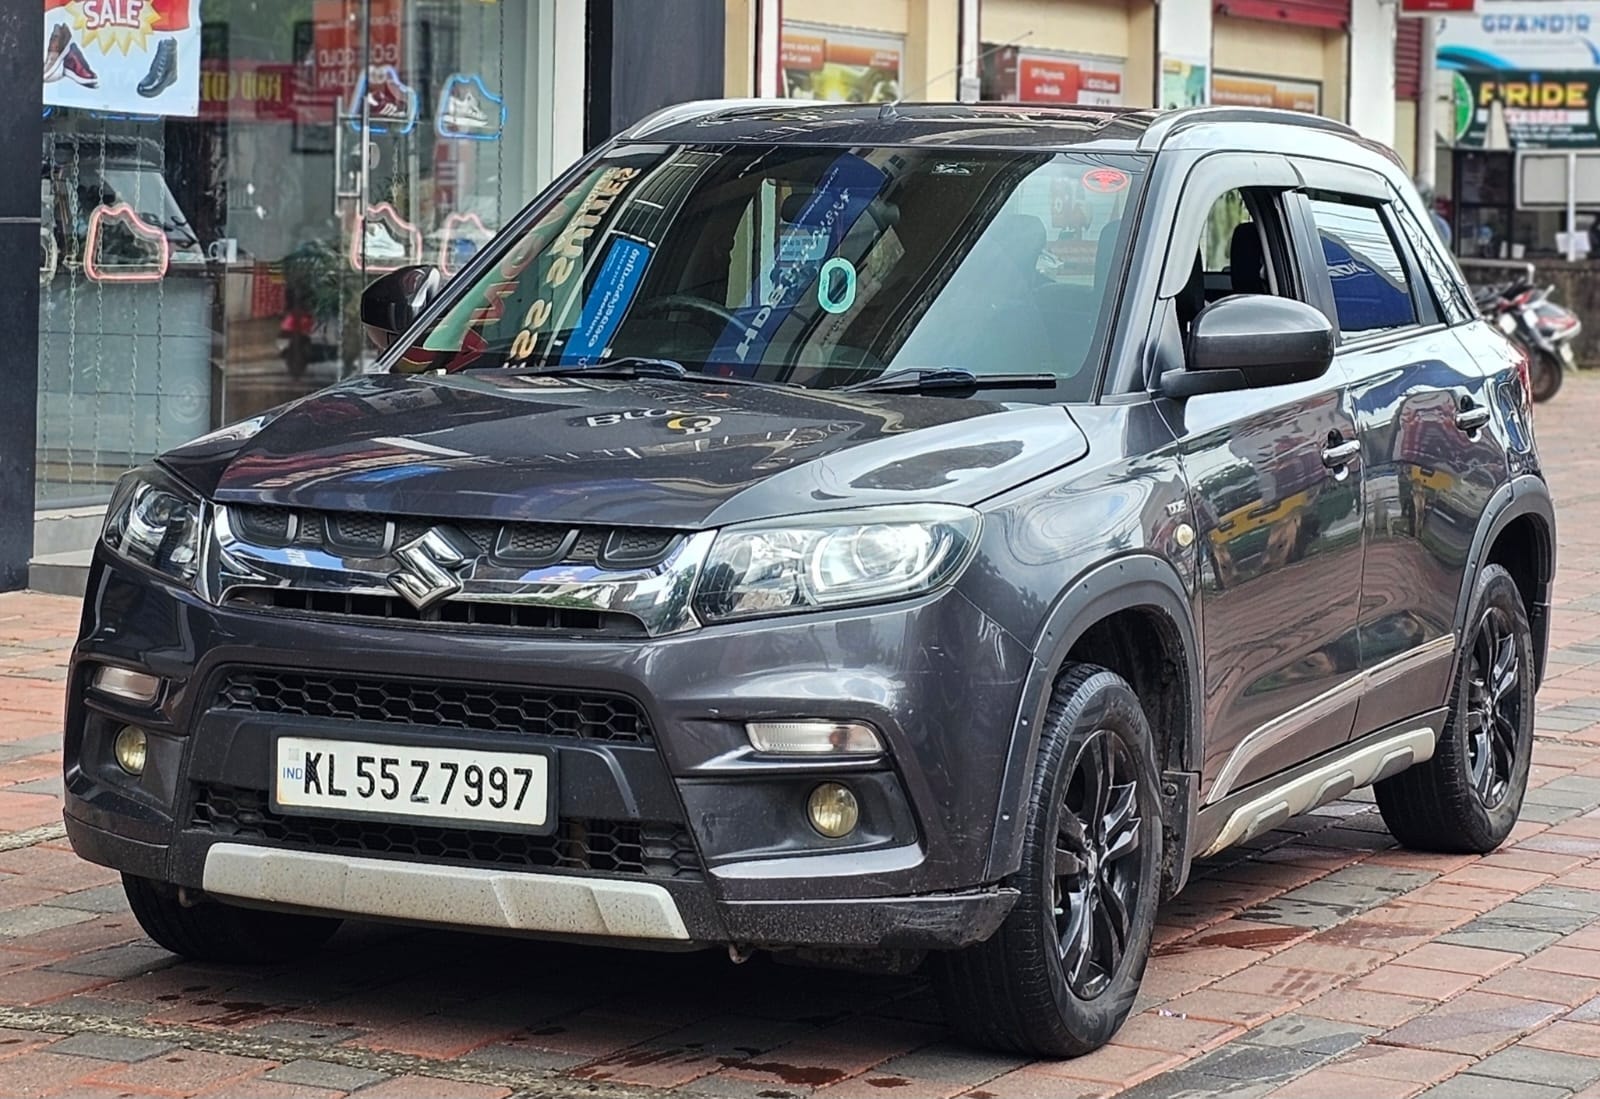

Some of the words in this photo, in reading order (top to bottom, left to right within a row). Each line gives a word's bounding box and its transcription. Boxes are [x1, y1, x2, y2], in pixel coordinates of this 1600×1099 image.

[83, 0, 143, 28] SALE
[1480, 81, 1588, 107] PRIDE
[283, 767, 304, 780] IND
[304, 751, 347, 797] KL
[356, 756, 400, 800] 55
[410, 760, 430, 804] Z
[440, 762, 534, 811] 7997
